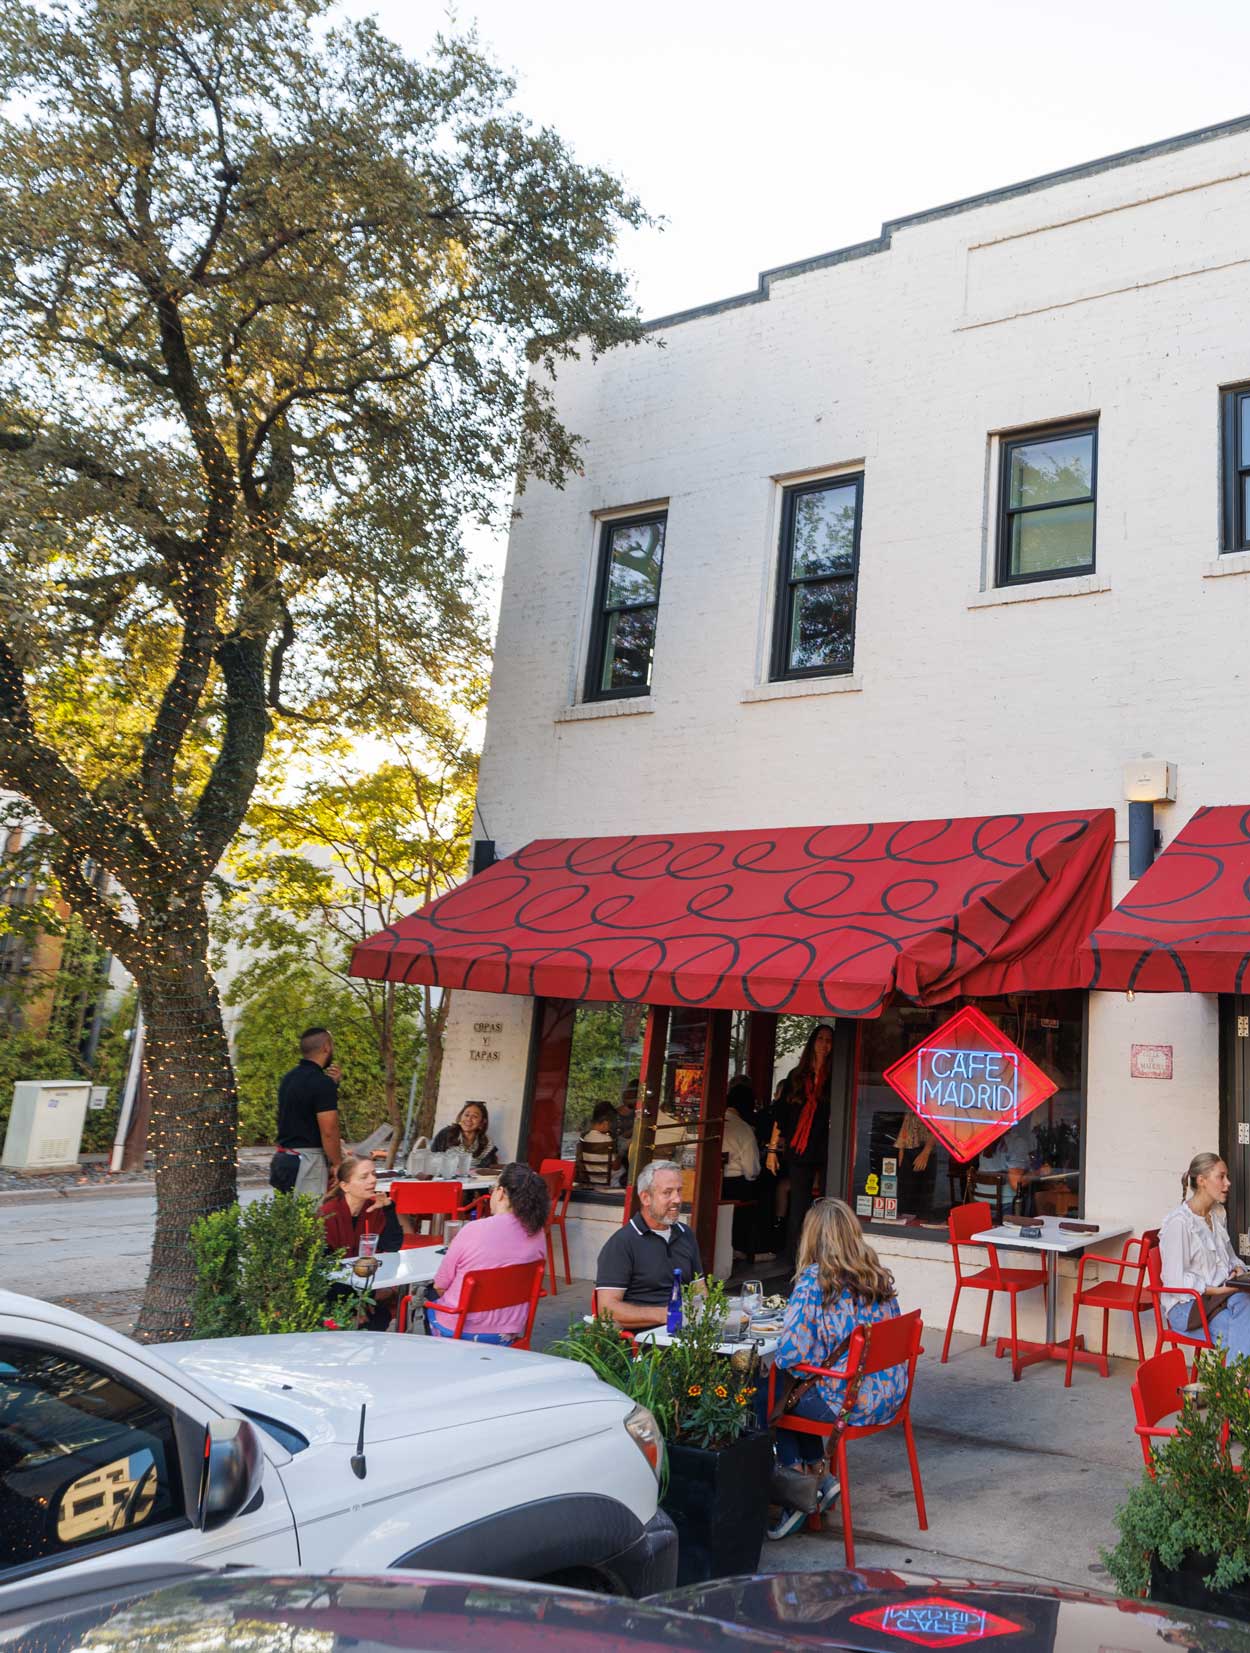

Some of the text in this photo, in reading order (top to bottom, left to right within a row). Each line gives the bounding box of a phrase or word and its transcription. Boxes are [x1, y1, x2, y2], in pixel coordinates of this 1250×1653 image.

[473, 1022, 504, 1033] COPAS
[482, 1036, 490, 1045] Y
[469, 1049, 500, 1061] TAPAS
[931, 1051, 1002, 1082] CAFE
[921, 1079, 1014, 1112] MADRID
